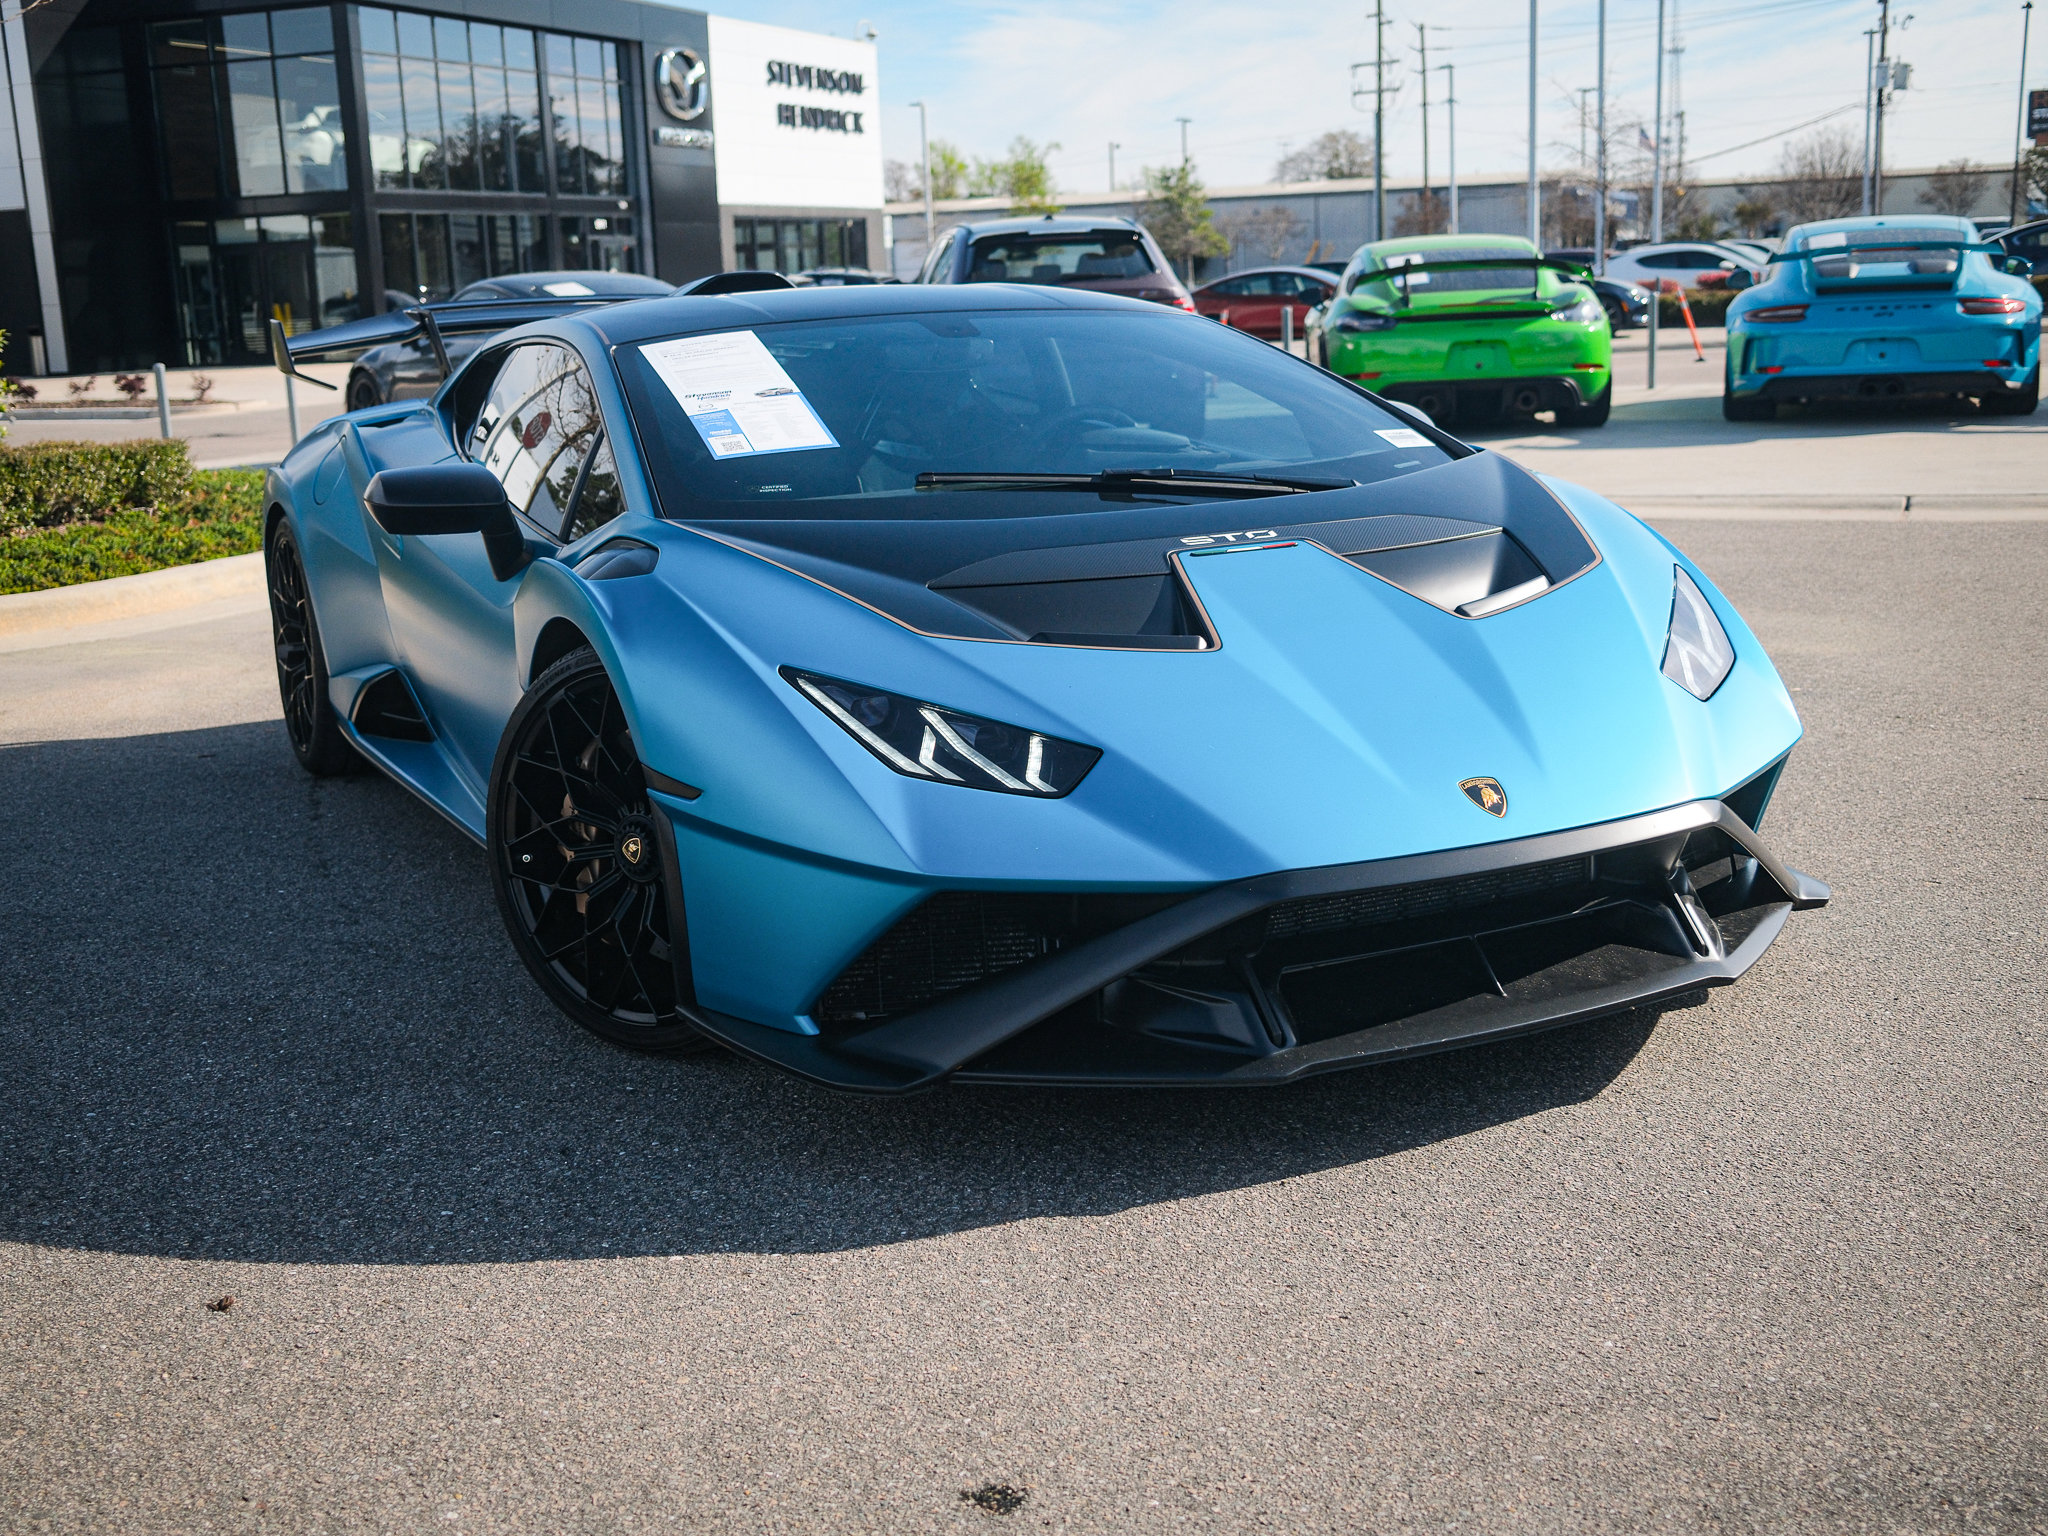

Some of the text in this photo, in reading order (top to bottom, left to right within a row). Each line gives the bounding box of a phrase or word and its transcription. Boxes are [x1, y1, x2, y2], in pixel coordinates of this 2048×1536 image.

[766, 59, 864, 94] STEVENSON
[777, 103, 864, 134] HENDRICK
[1180, 530, 1278, 545] STO
